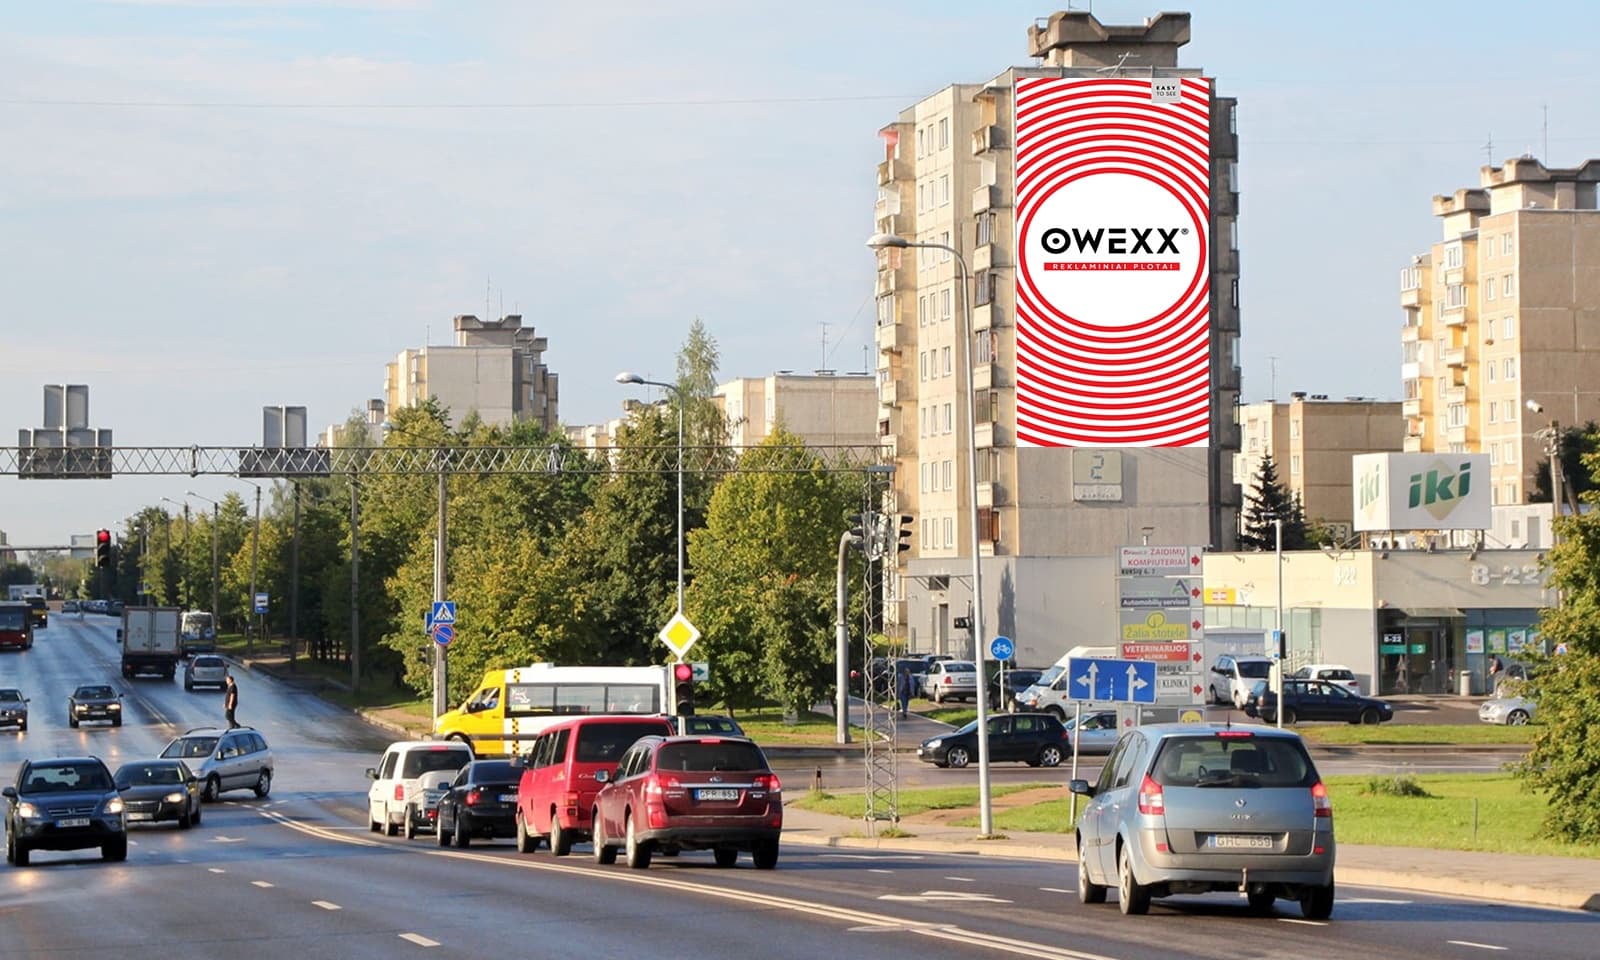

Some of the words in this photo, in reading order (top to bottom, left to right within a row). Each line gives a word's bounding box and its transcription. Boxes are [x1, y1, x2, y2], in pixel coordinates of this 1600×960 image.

[1090, 455, 1105, 480] 2
[1360, 463, 1379, 510] iki
[1408, 461, 1471, 509] iki
[1124, 645, 1187, 653] VETERINARIJOS
[1162, 679, 1188, 688] KLINIKA
